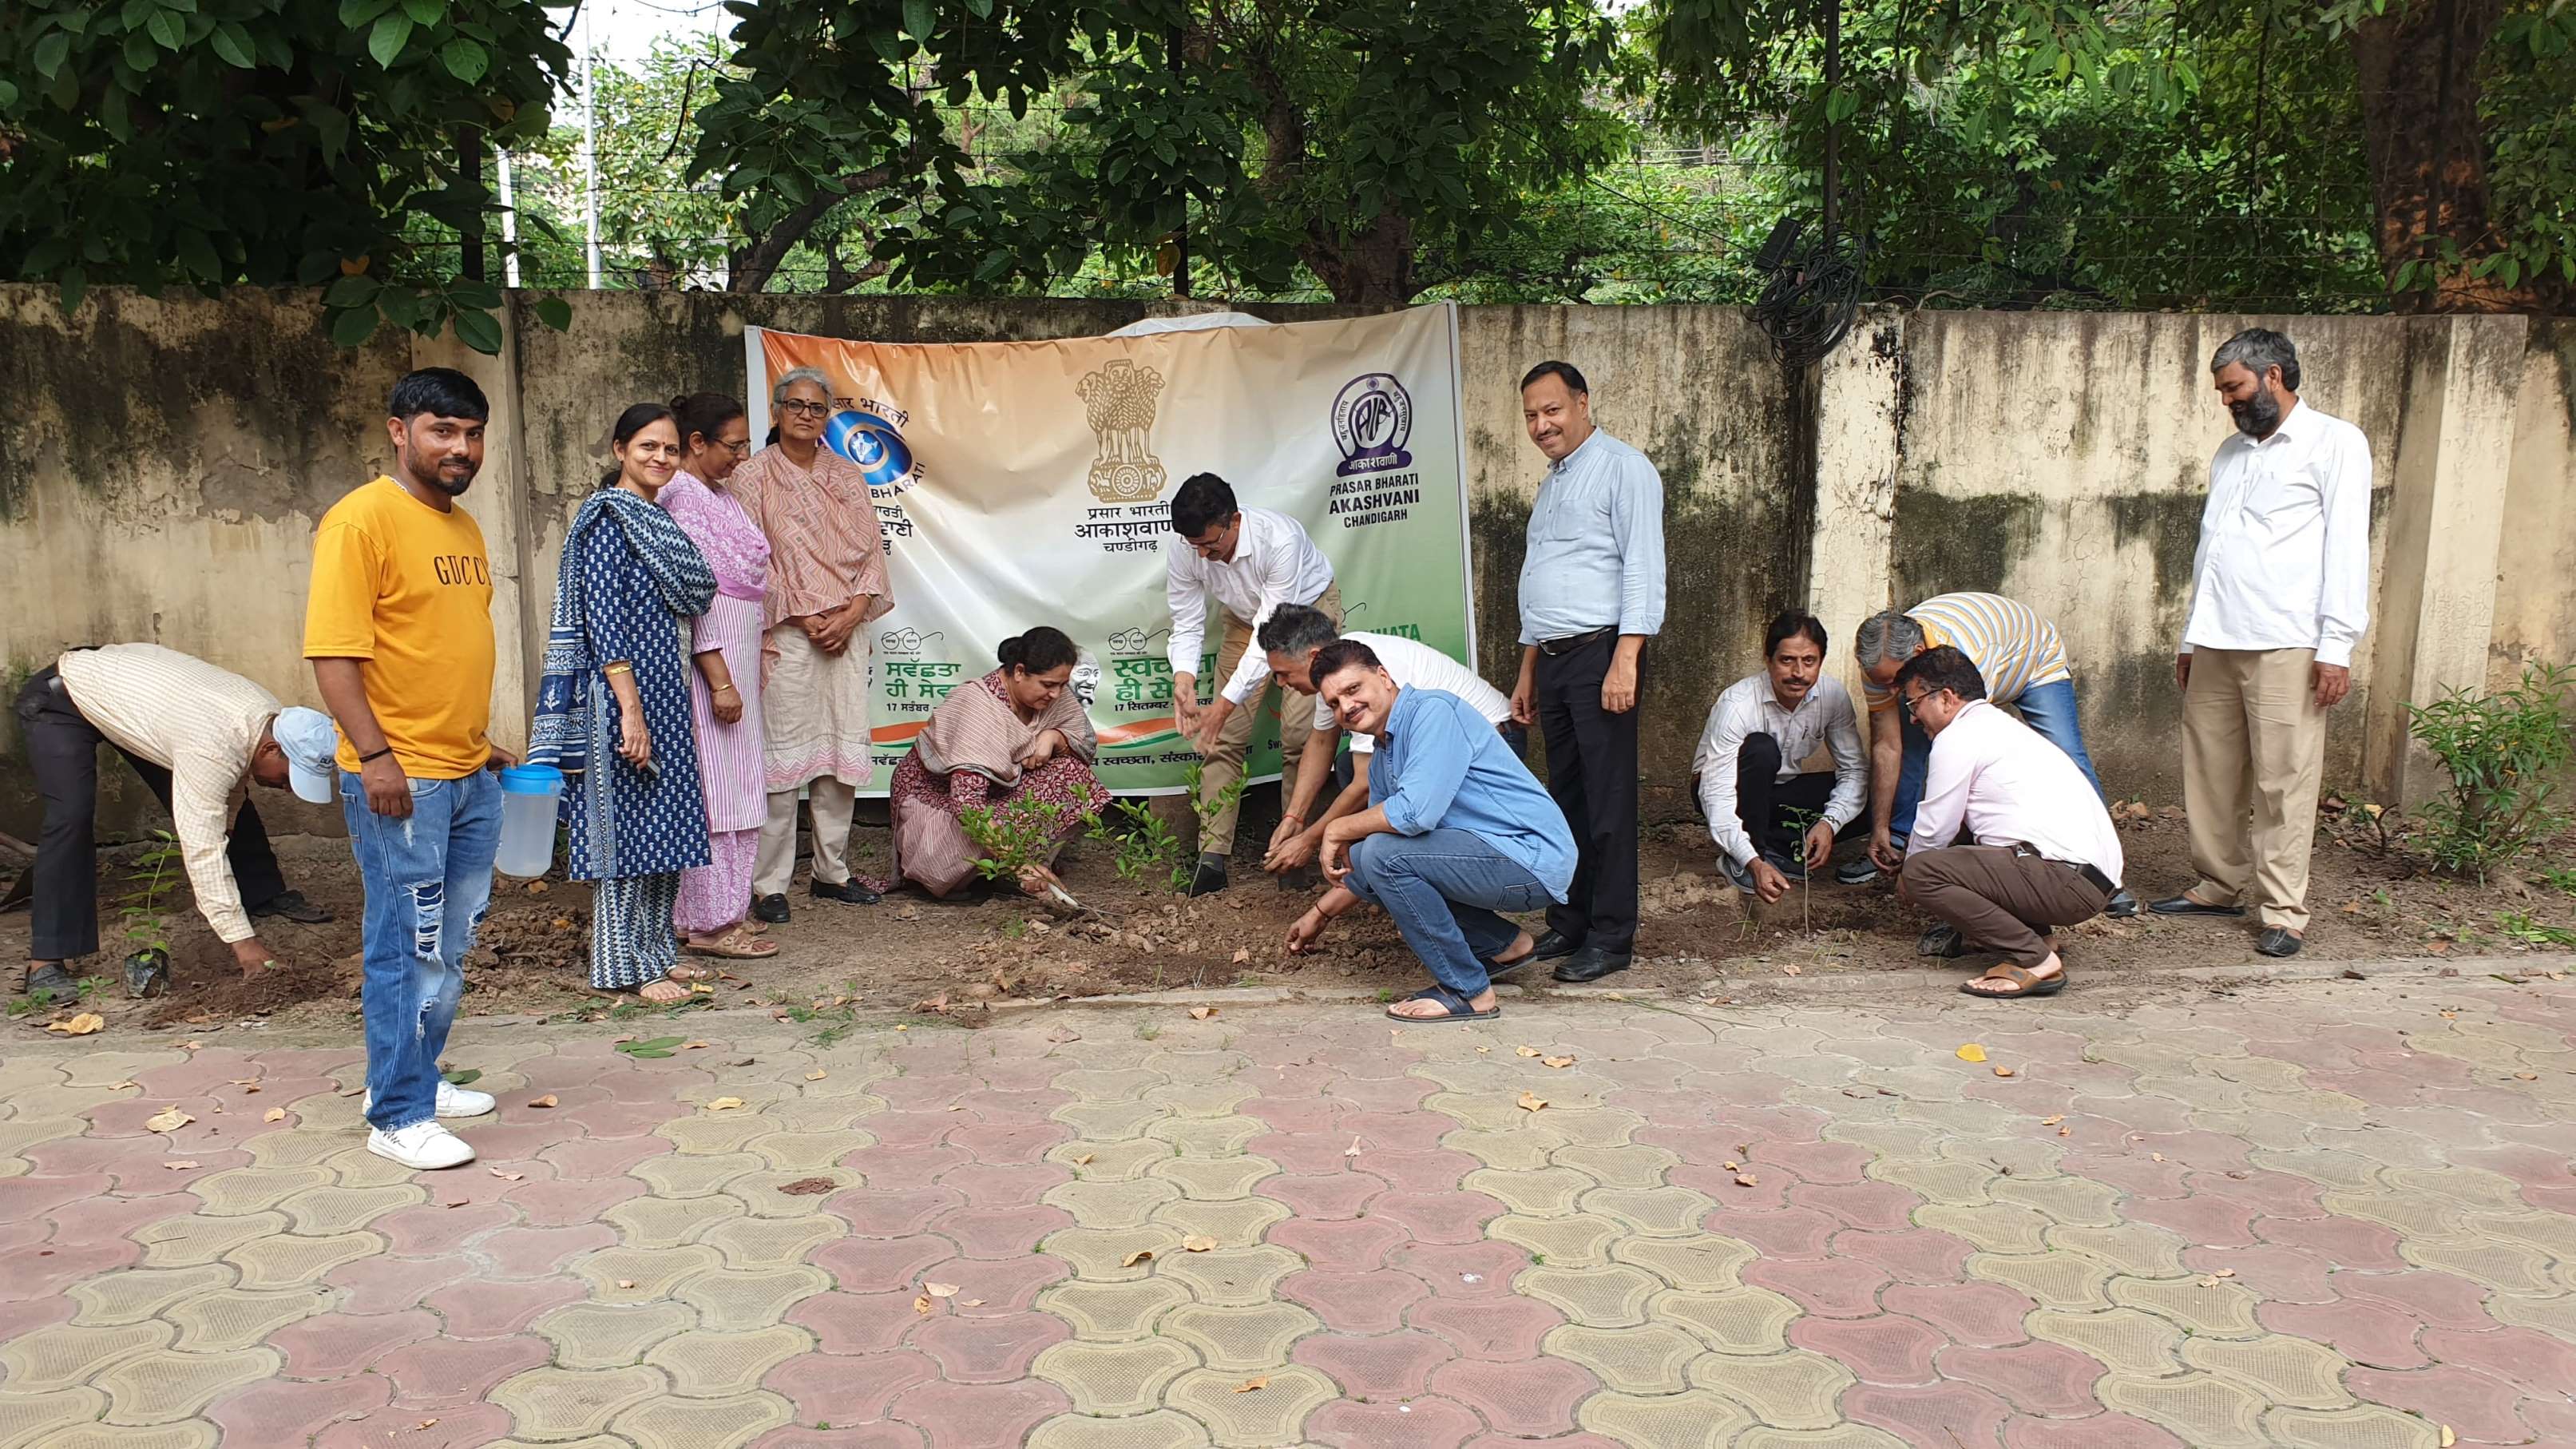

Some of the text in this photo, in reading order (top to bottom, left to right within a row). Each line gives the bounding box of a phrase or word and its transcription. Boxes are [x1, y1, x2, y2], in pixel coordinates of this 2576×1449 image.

[860, 398, 910, 428] भारती
[871, 462, 926, 498] BHARATI
[1330, 473, 1419, 497] PRASAR BHARATI
[1087, 501, 1171, 520] प्रसार भारती
[1329, 489, 1420, 514] AKASHVANI
[1344, 509, 1408, 528] CHANDIGARH
[1103, 538, 1158, 553] चण्डीगढ़
[886, 657, 961, 677] ਸਵੱਛਤਾ
[885, 678, 909, 698] ਹੀ
[1114, 678, 1143, 701] ही
[886, 703, 897, 712] 17
